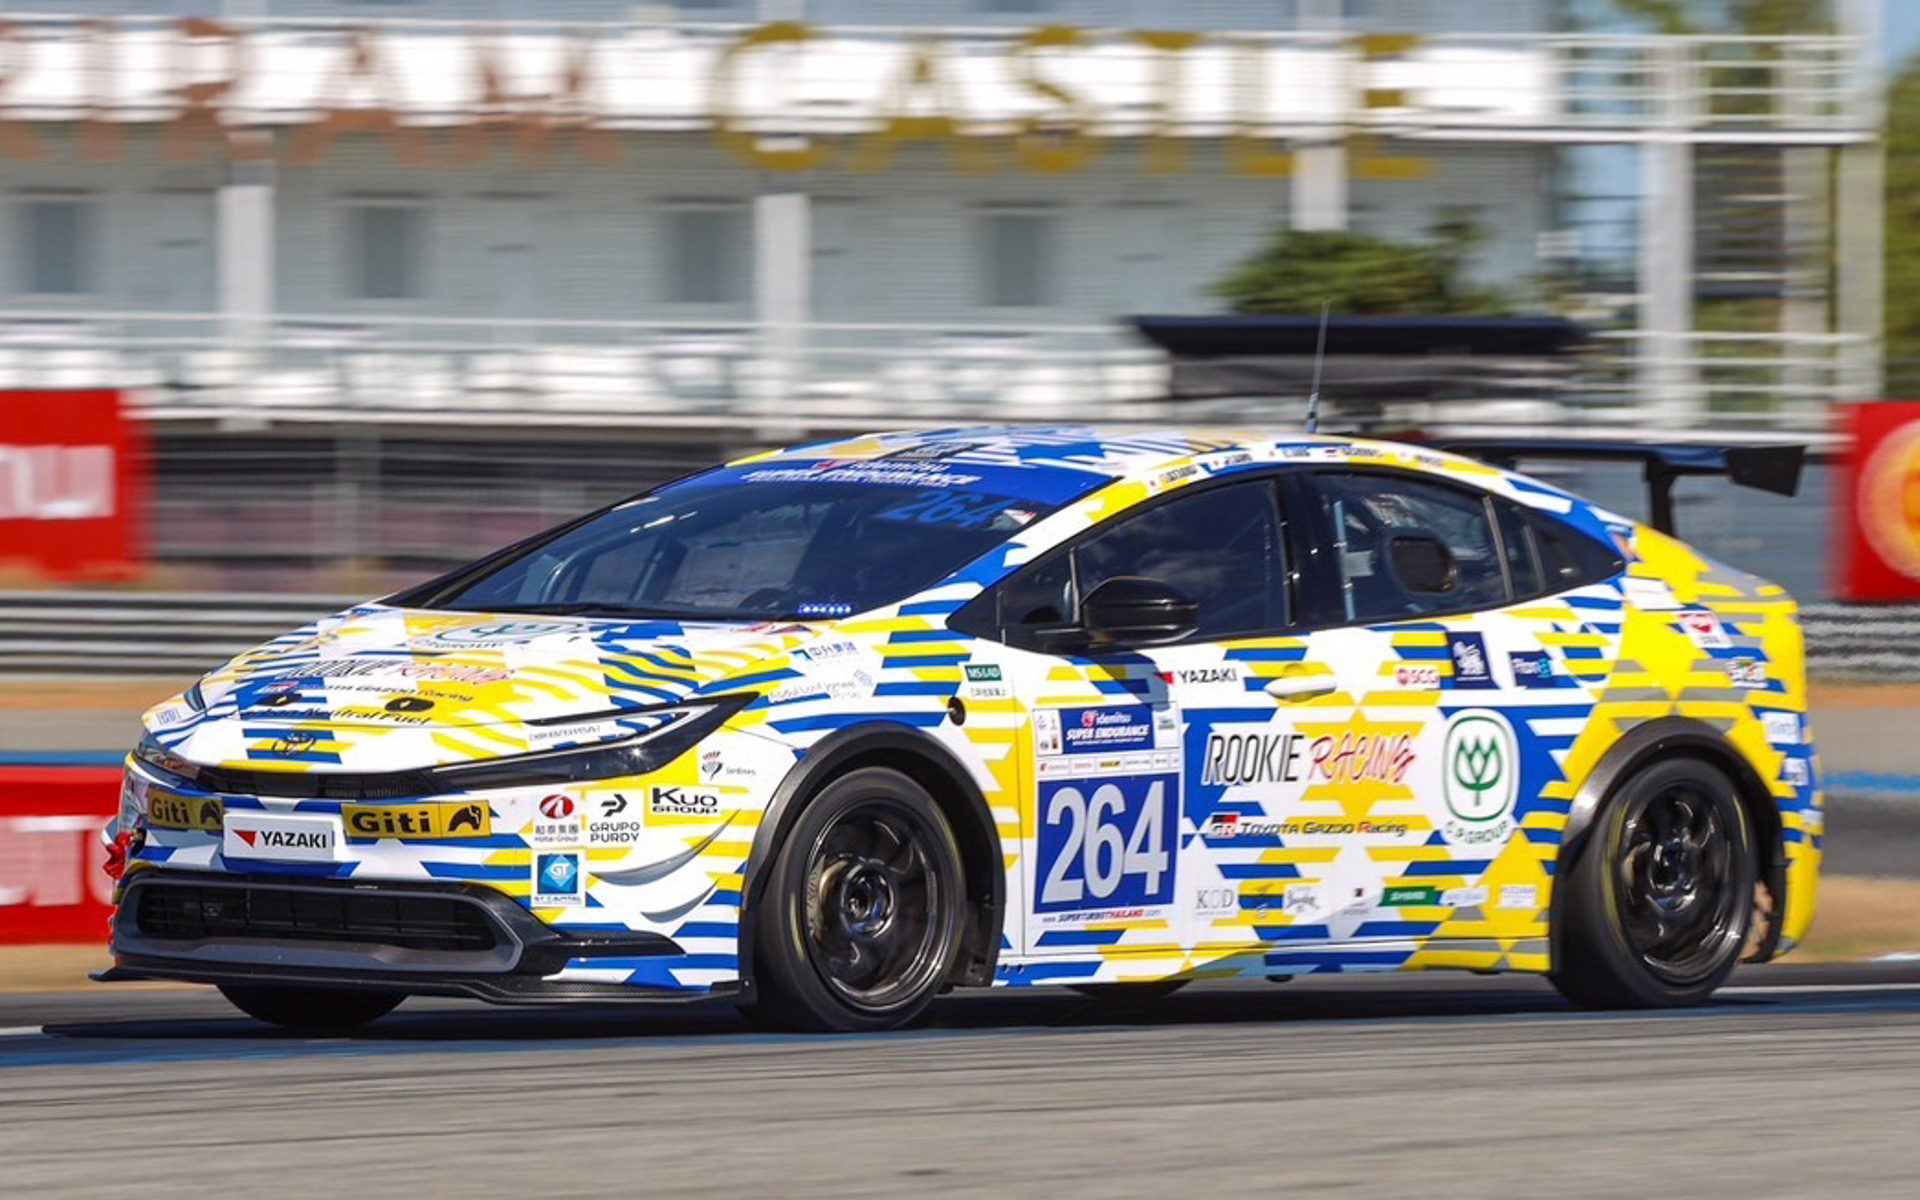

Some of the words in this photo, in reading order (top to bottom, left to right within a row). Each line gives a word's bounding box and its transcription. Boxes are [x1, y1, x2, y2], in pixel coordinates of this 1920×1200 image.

[876, 490, 1013, 527] 264
[1177, 668, 1238, 684] YAZAKI
[376, 710, 432, 725] Fuel
[1066, 727, 1094, 740] SUPER
[1094, 724, 1151, 739] ENDURANCE
[1203, 734, 1304, 783] ROOKIE
[1309, 732, 1416, 784] RACING
[152, 796, 191, 824] Giti
[652, 805, 718, 814] GROUP
[351, 810, 431, 834] Giti
[590, 822, 640, 832] GRUPO
[1239, 822, 1298, 834] TOYOTA
[1302, 822, 1354, 834] GAZOO
[1356, 821, 1409, 837] Racing
[260, 830, 327, 849] YAZAKI
[590, 832, 640, 843] PURDY
[1041, 780, 1169, 904] 264
